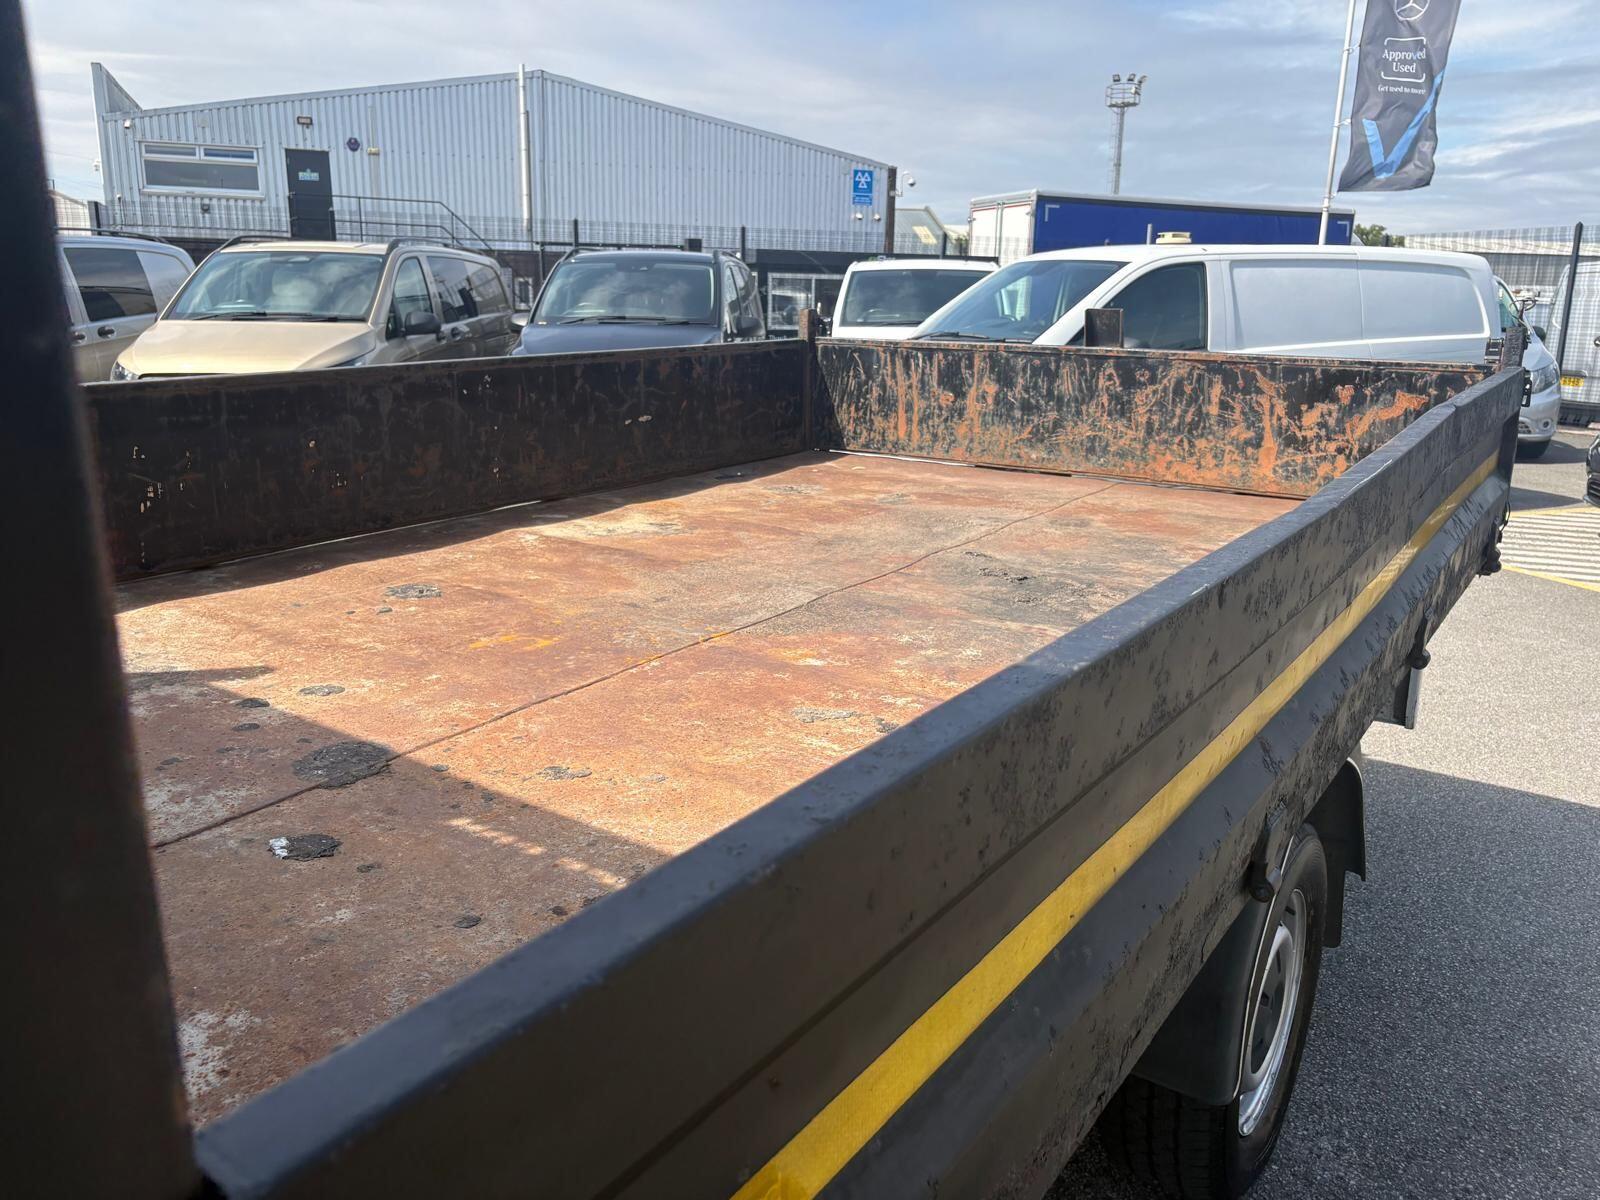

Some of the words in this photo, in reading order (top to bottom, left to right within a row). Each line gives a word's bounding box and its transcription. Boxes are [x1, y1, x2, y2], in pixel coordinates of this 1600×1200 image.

[1382, 48, 1426, 61] Approved
[1392, 61, 1416, 73] Used
[1378, 84, 1389, 92] Get
